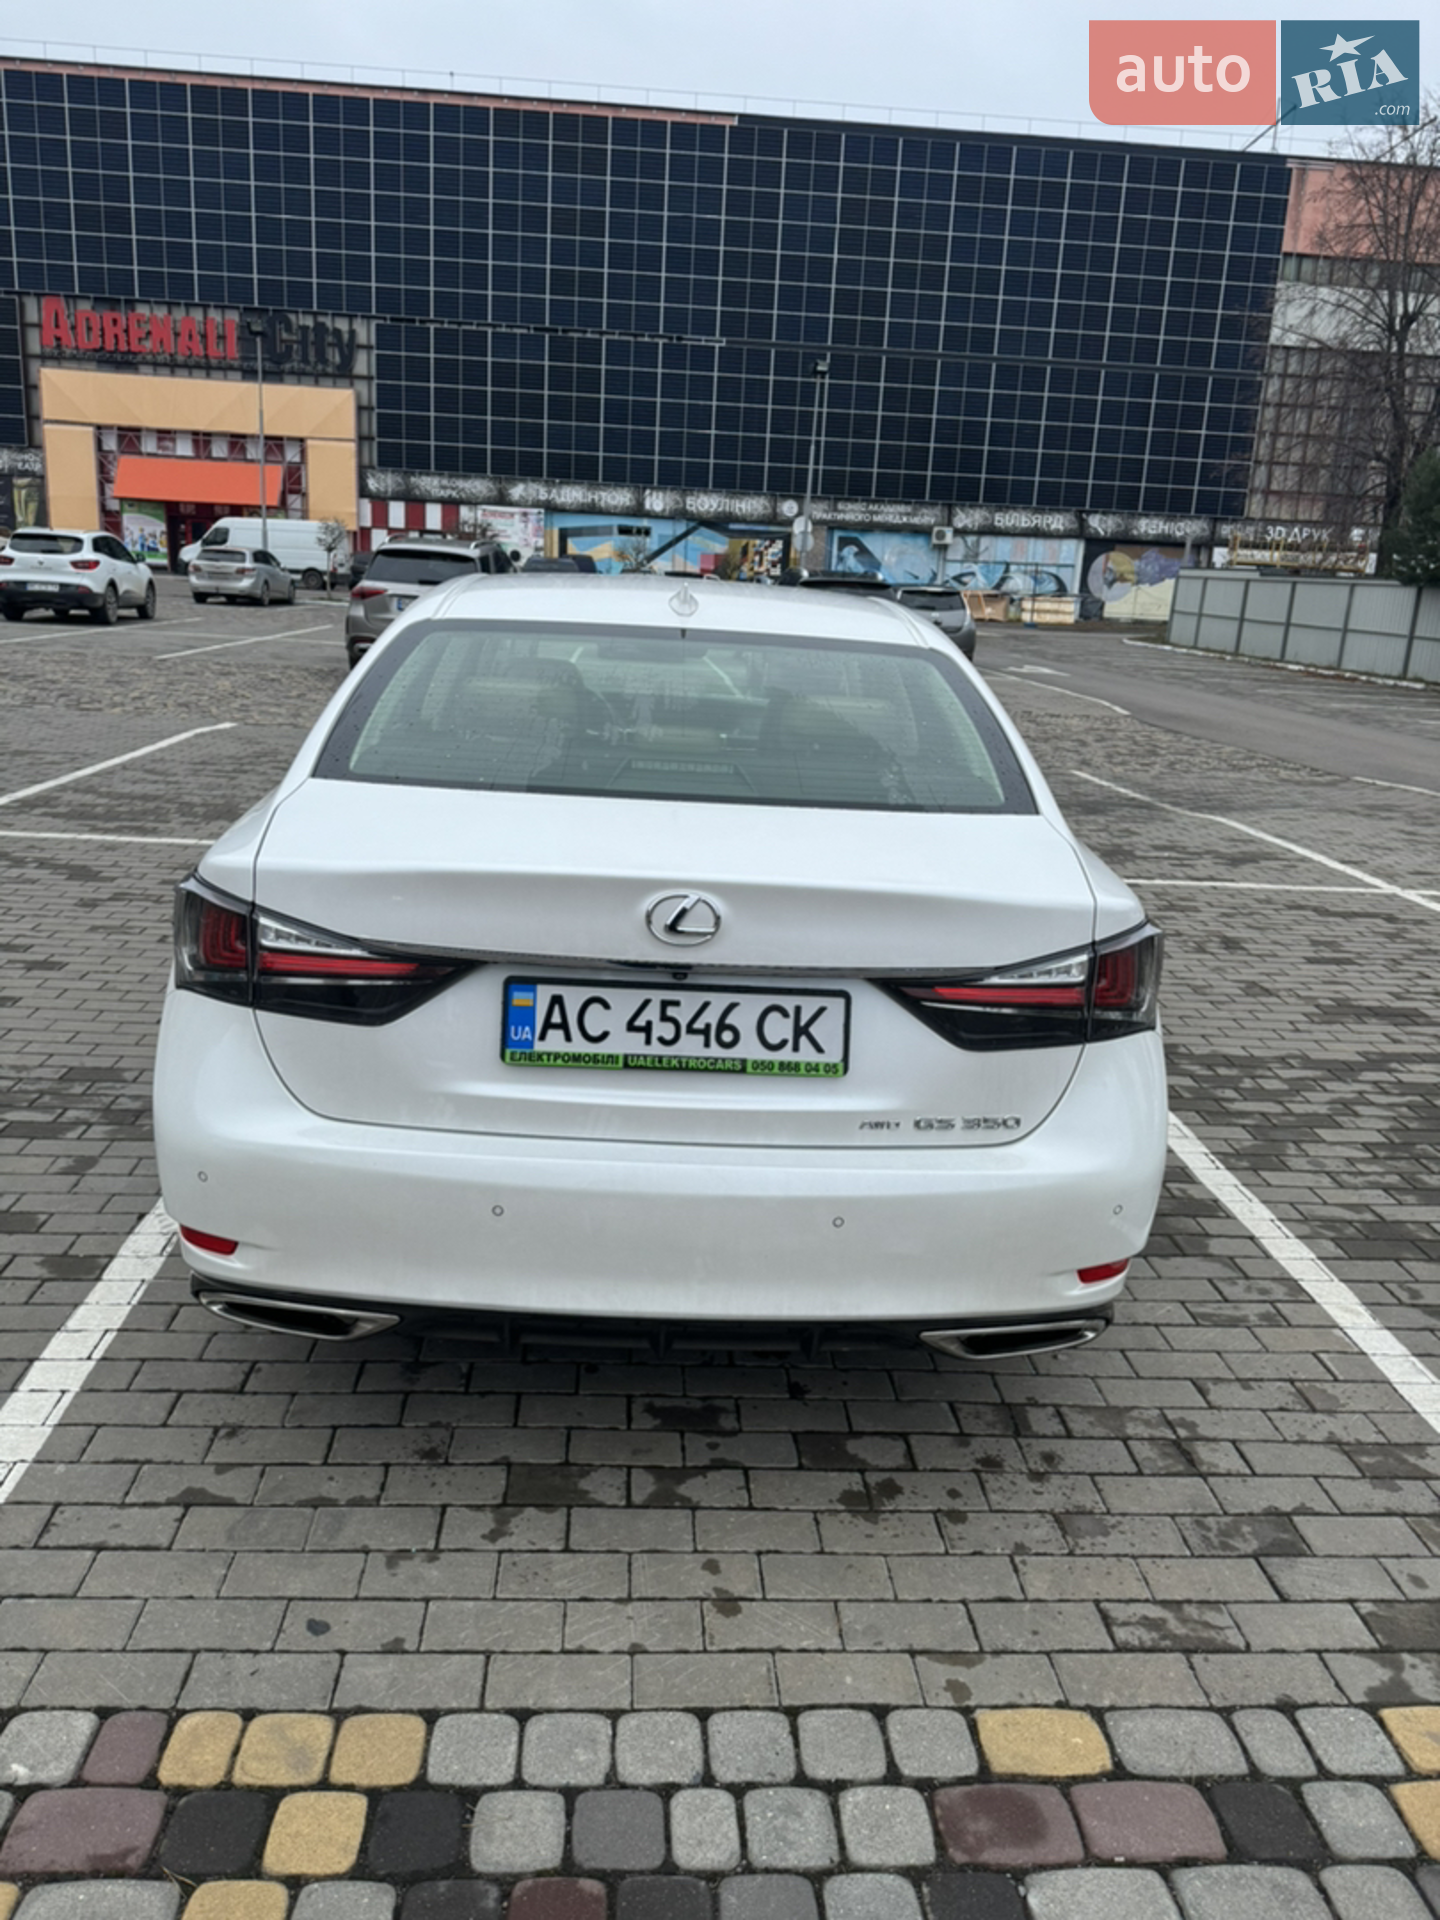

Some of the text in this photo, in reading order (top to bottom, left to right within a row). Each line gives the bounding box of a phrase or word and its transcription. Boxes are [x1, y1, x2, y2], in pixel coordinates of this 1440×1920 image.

[993, 511, 1065, 530] БІЛЬЯРД
[1265, 525, 1286, 541] 3D
[538, 994, 828, 1055] AC 4546 CK
[511, 1026, 532, 1041] UA
[751, 1060, 775, 1074] 050
[804, 1063, 822, 1075] 04
[824, 1063, 840, 1076] 05
[913, 1116, 956, 1132] GS
[960, 1115, 1022, 1131] 350
